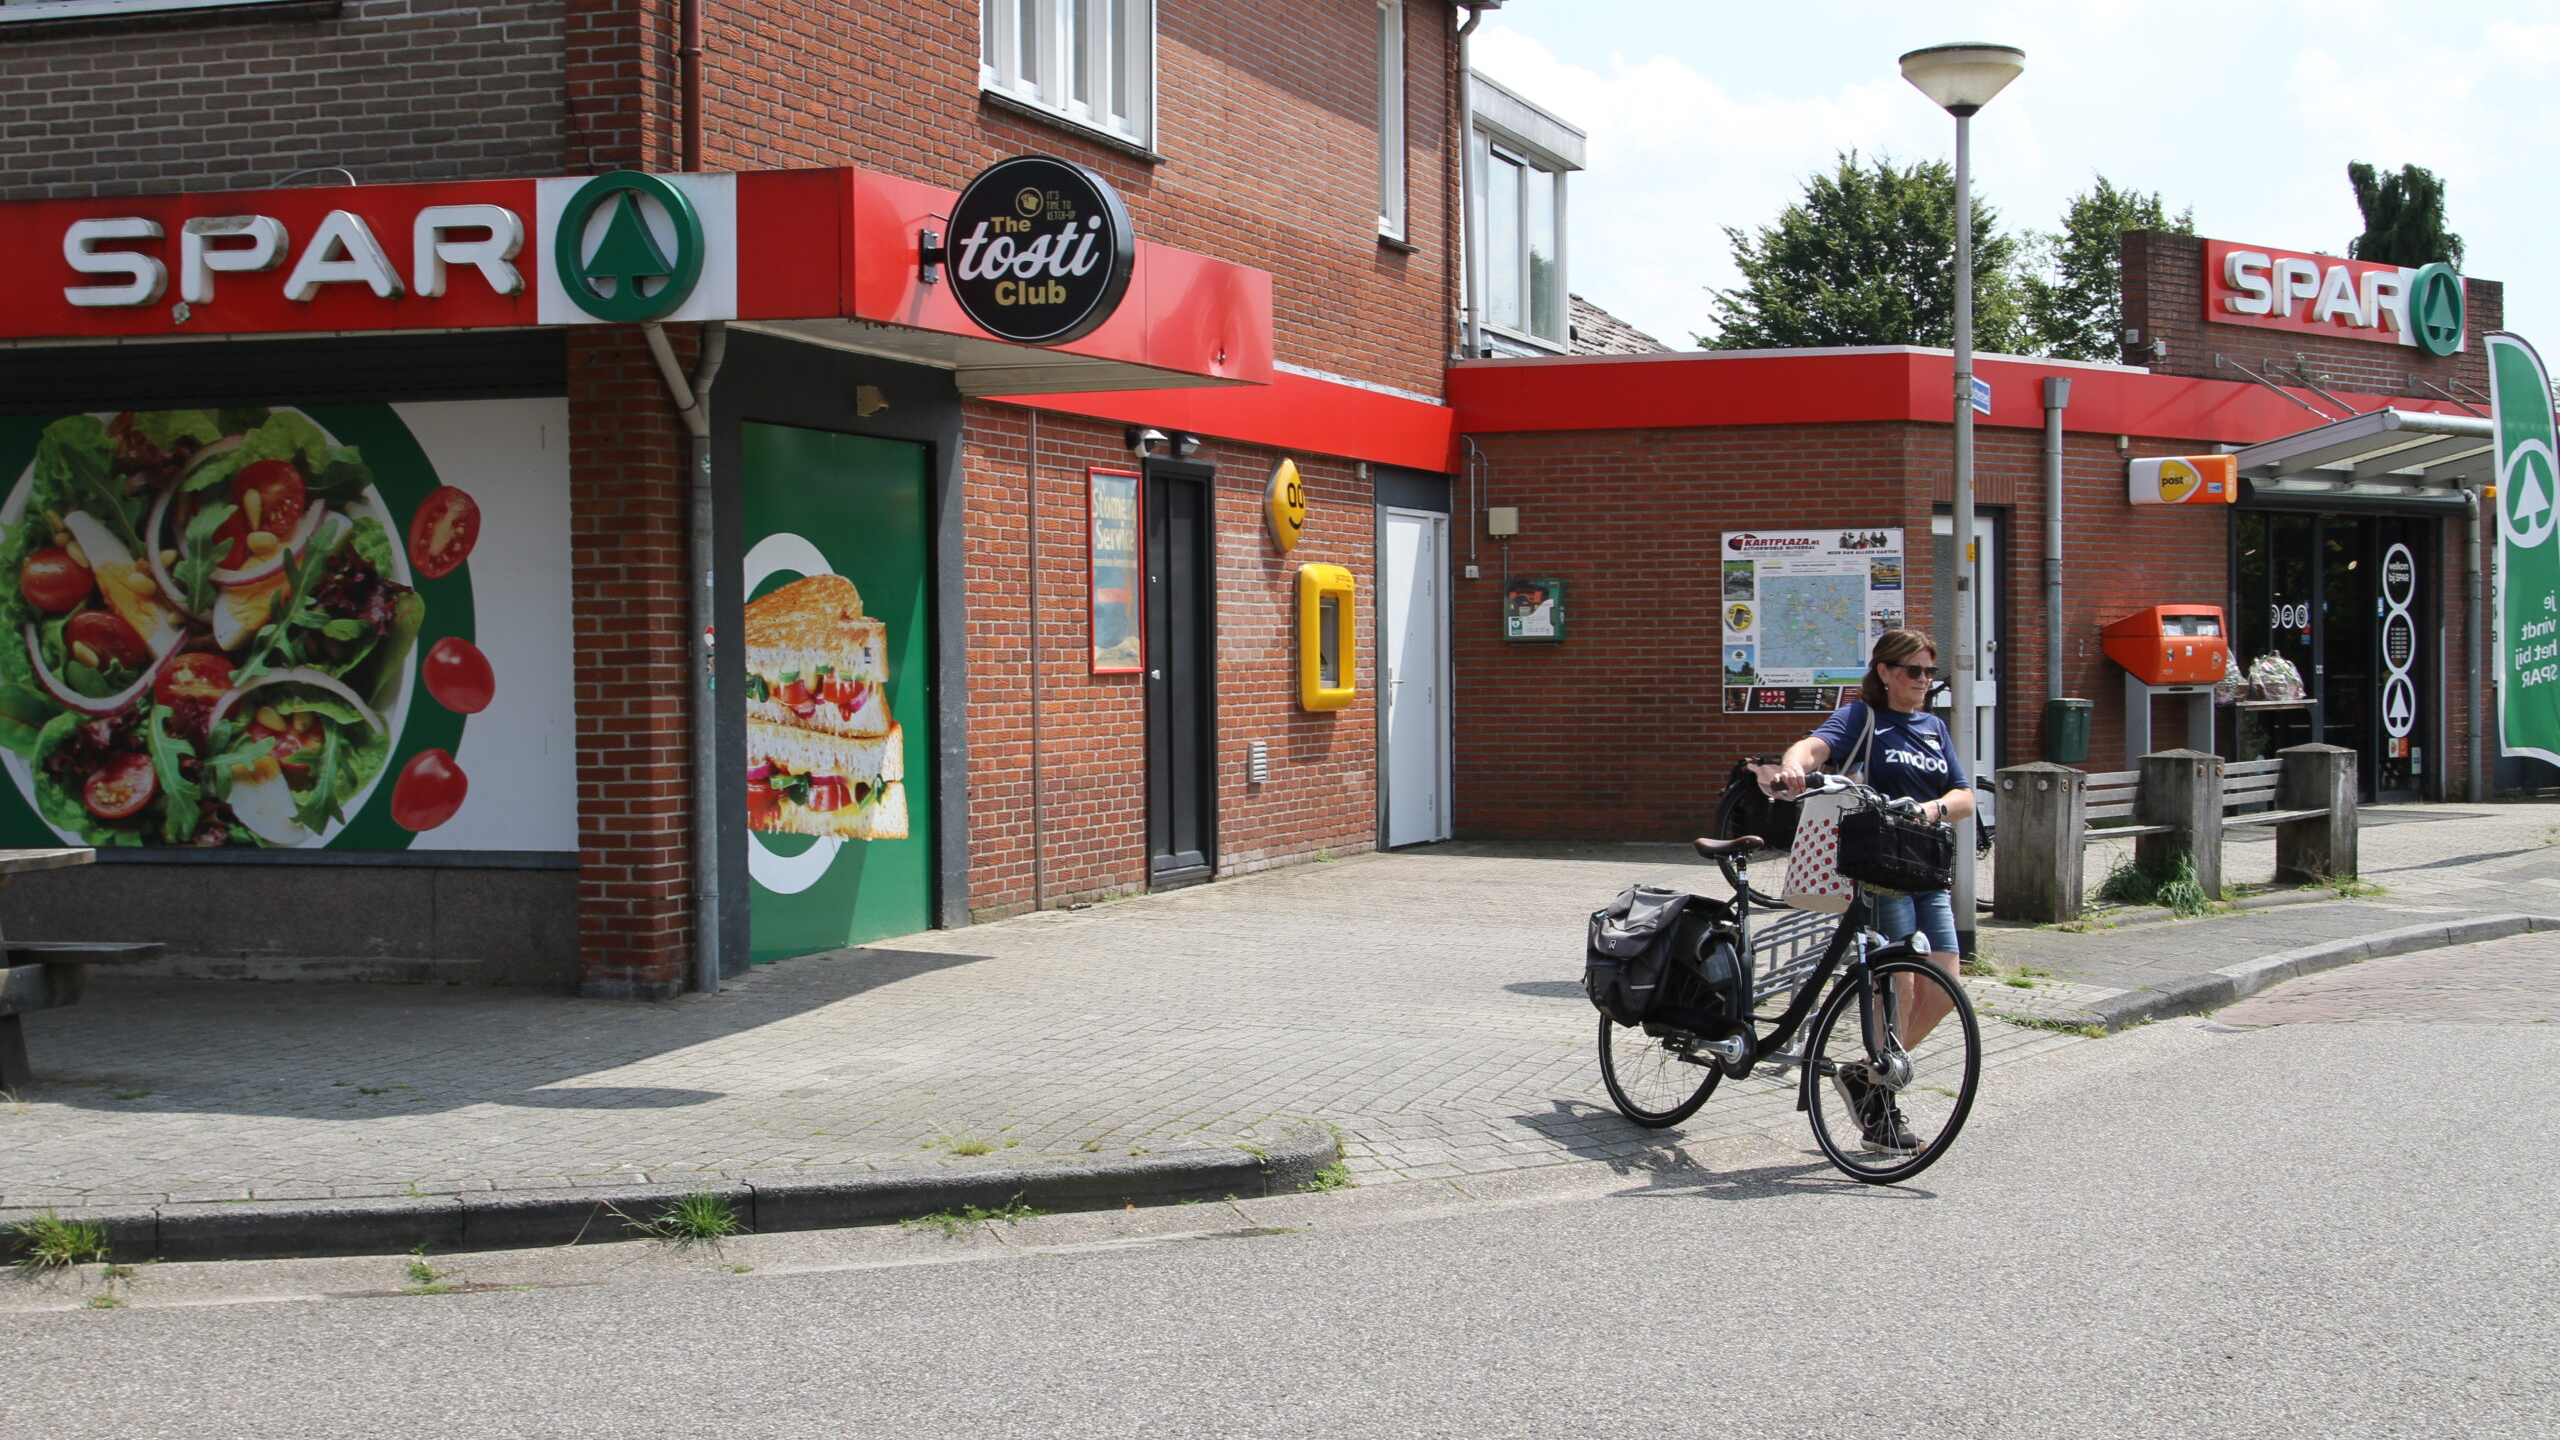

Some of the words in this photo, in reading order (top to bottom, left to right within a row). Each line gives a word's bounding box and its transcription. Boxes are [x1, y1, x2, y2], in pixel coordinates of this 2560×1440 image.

[1062, 200, 1072, 210] TO
[990, 216, 1032, 234] The
[63, 204, 526, 307] SPAR
[958, 215, 1102, 281] tosti
[995, 280, 1067, 306] Club
[2224, 250, 2404, 332] SPAR
[1096, 520, 1136, 552] Service
[1871, 609, 1901, 618] HEART
